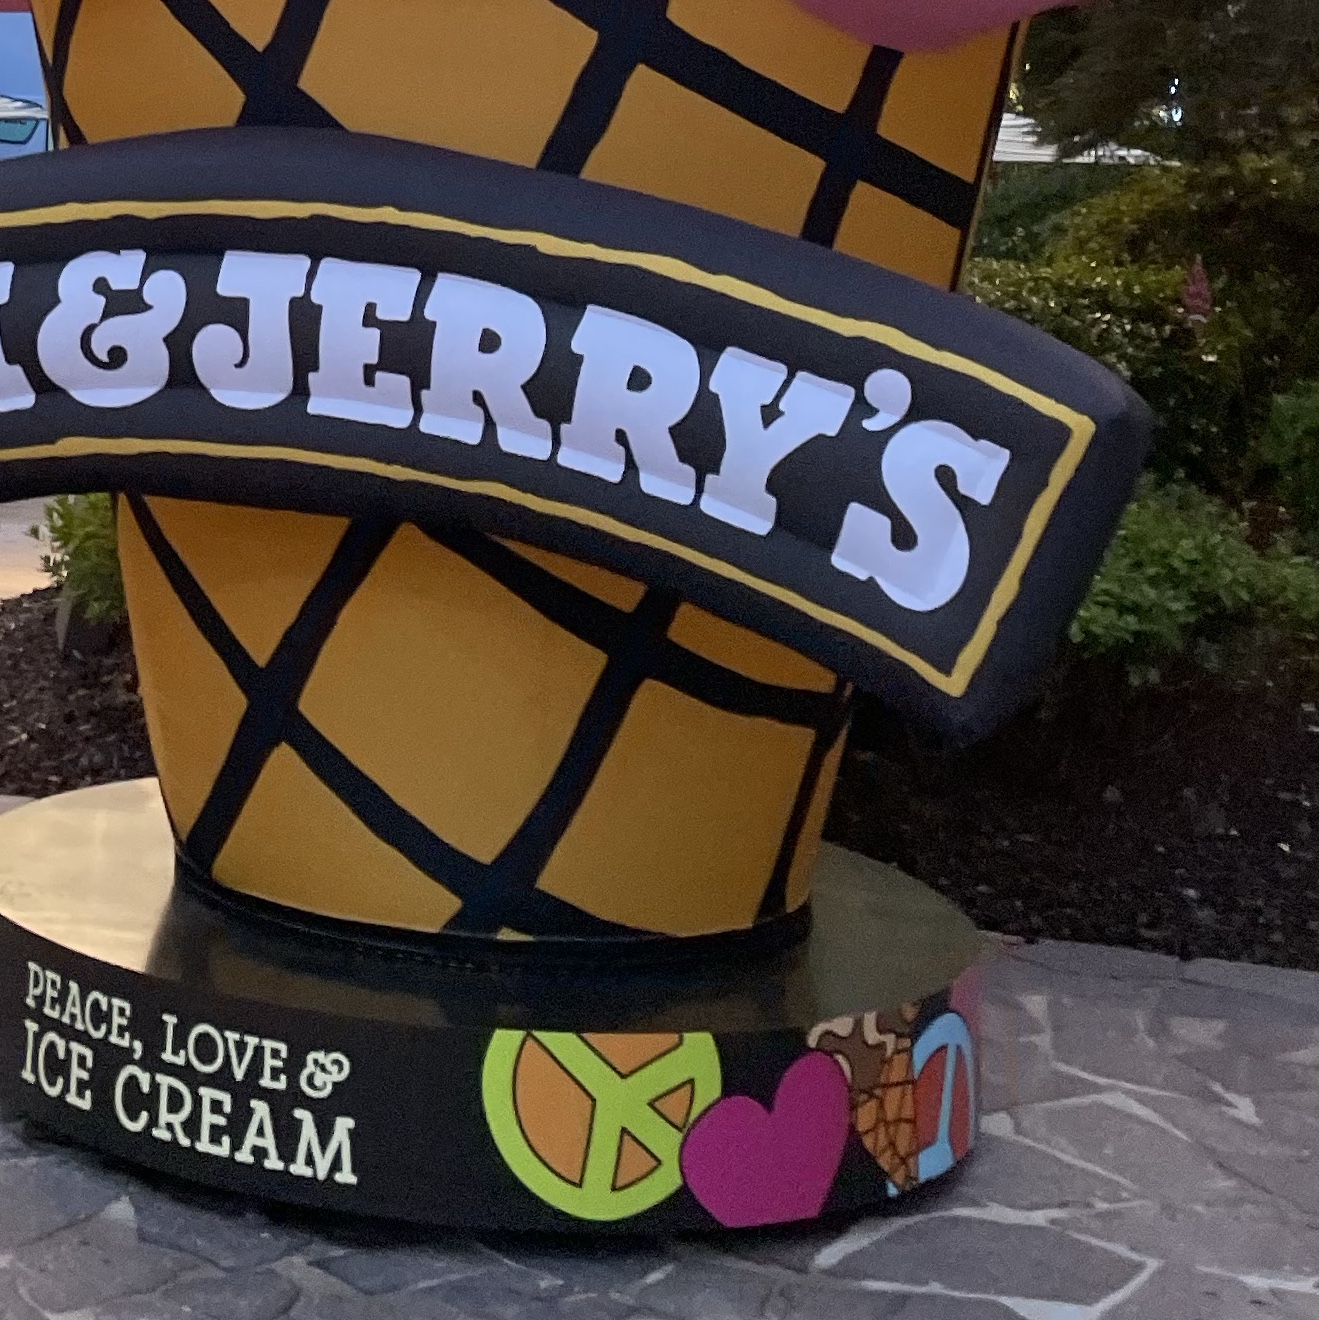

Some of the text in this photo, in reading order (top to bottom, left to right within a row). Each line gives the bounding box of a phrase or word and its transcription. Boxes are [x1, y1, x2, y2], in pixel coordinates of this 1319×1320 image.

[21, 1019, 357, 1185] ICE CREAM
[25, 961, 350, 1098] PEACE, LOVE &
